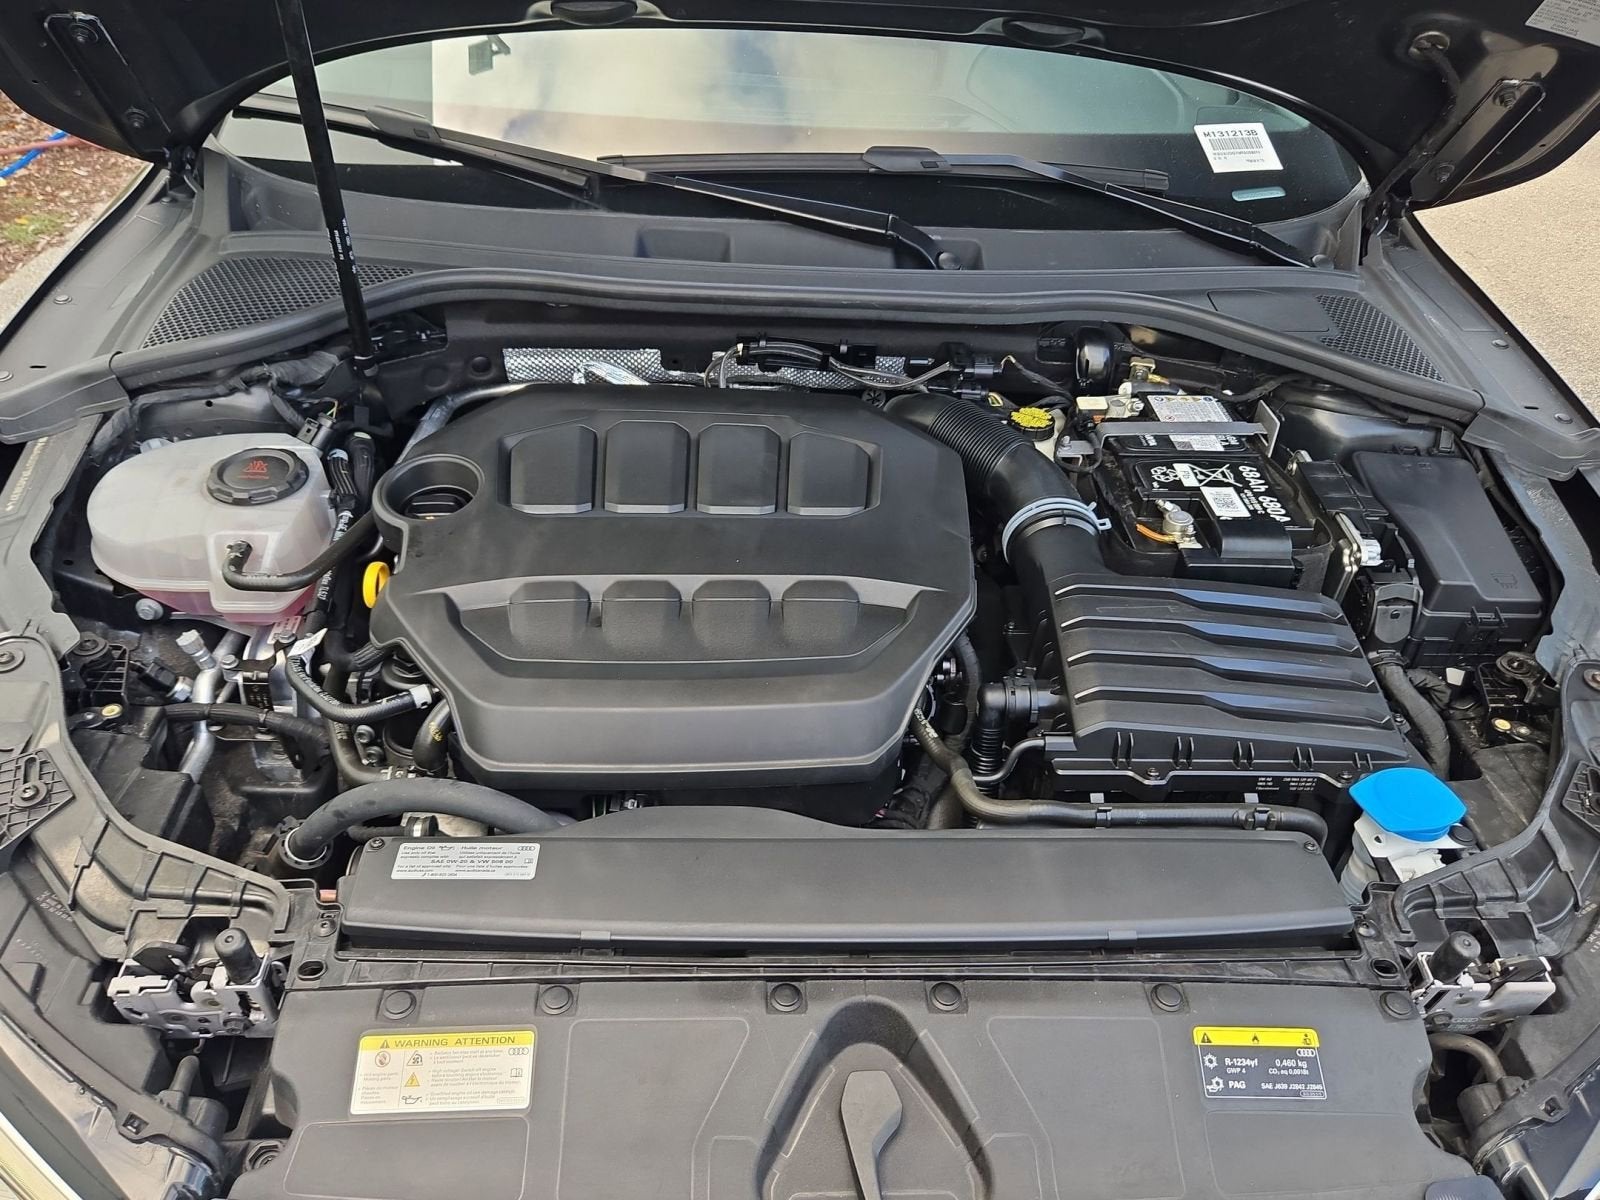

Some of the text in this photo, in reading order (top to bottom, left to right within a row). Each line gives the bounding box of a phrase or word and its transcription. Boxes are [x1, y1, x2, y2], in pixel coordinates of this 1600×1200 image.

[1238, 466, 1268, 492] 68Ah
[1258, 496, 1291, 522] 680A
[394, 1036, 516, 1047] WARNING ATTENTION
[1224, 1058, 1258, 1067] R-1234yf
[1298, 1060, 1307, 1068] kg
[1228, 1080, 1246, 1089] PAG
